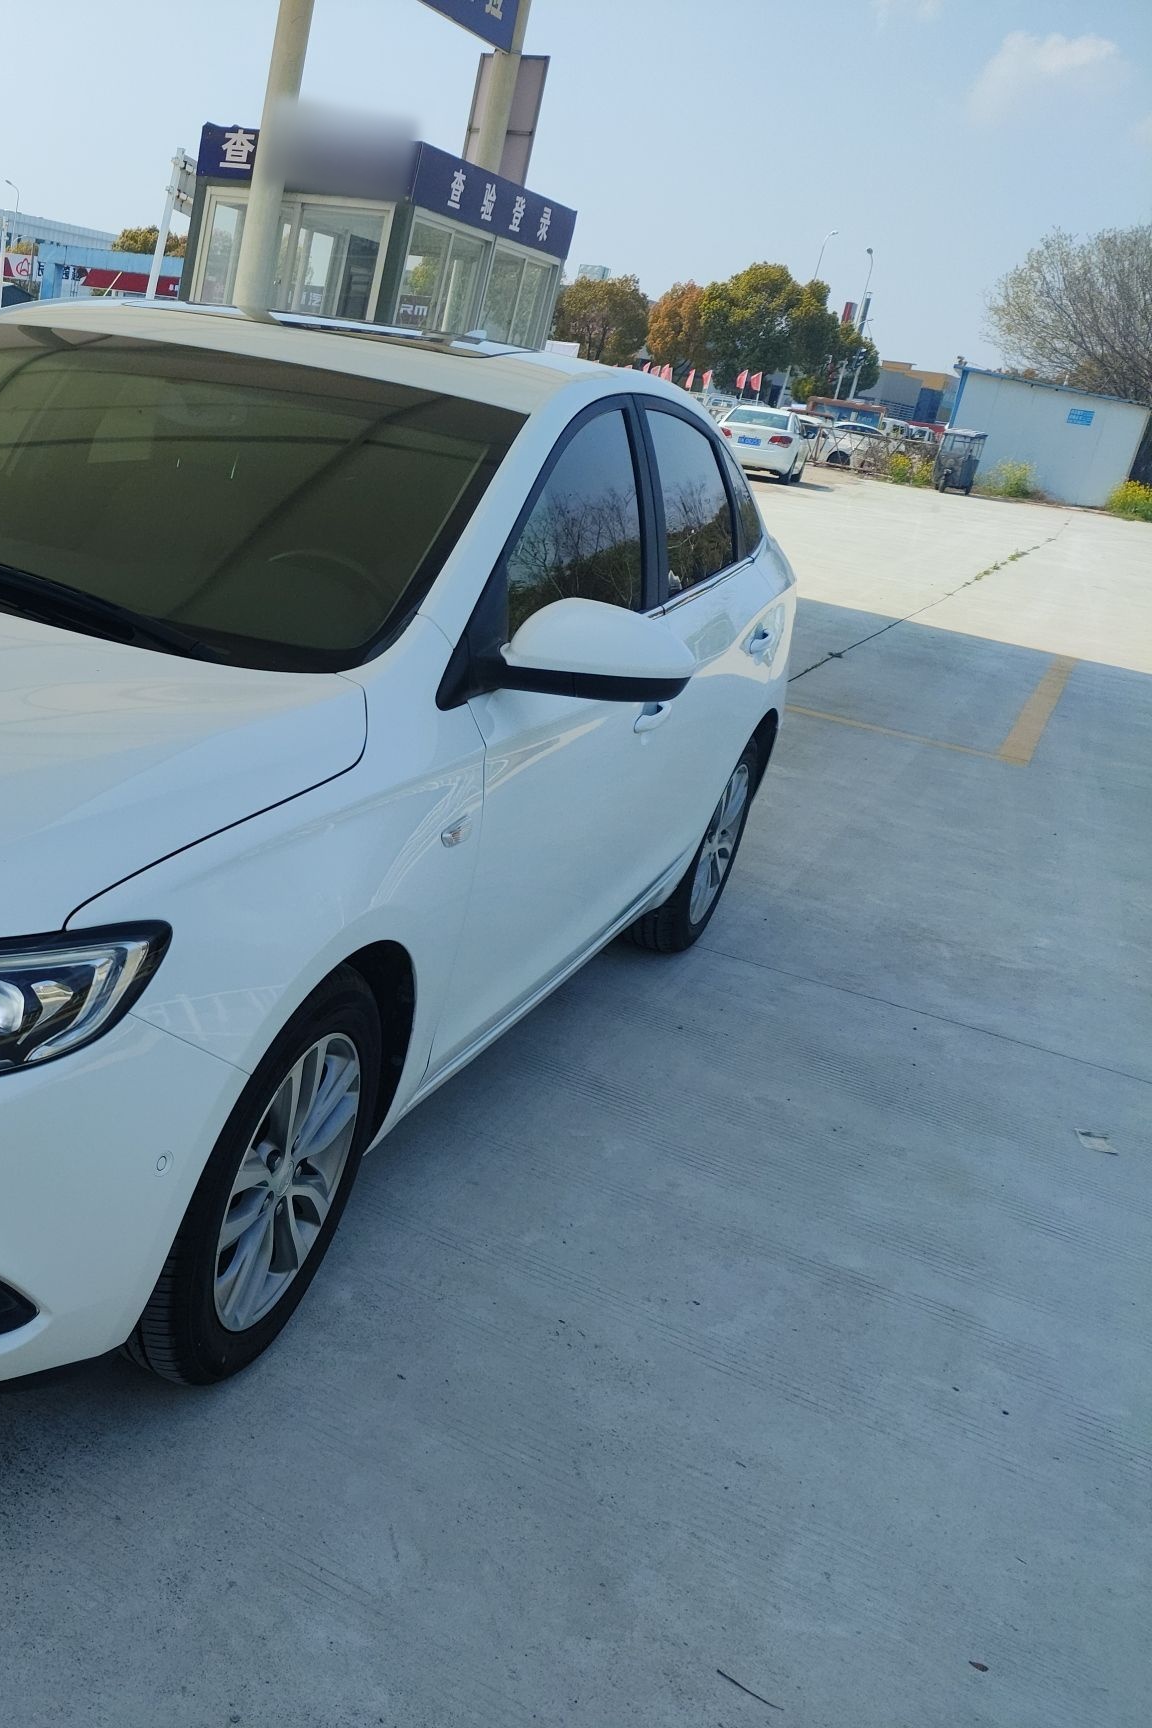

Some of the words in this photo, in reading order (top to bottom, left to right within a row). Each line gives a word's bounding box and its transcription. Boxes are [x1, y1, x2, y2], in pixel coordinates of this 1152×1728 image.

[219, 128, 256, 170] 查
[447, 168, 552, 242] 查验登录
